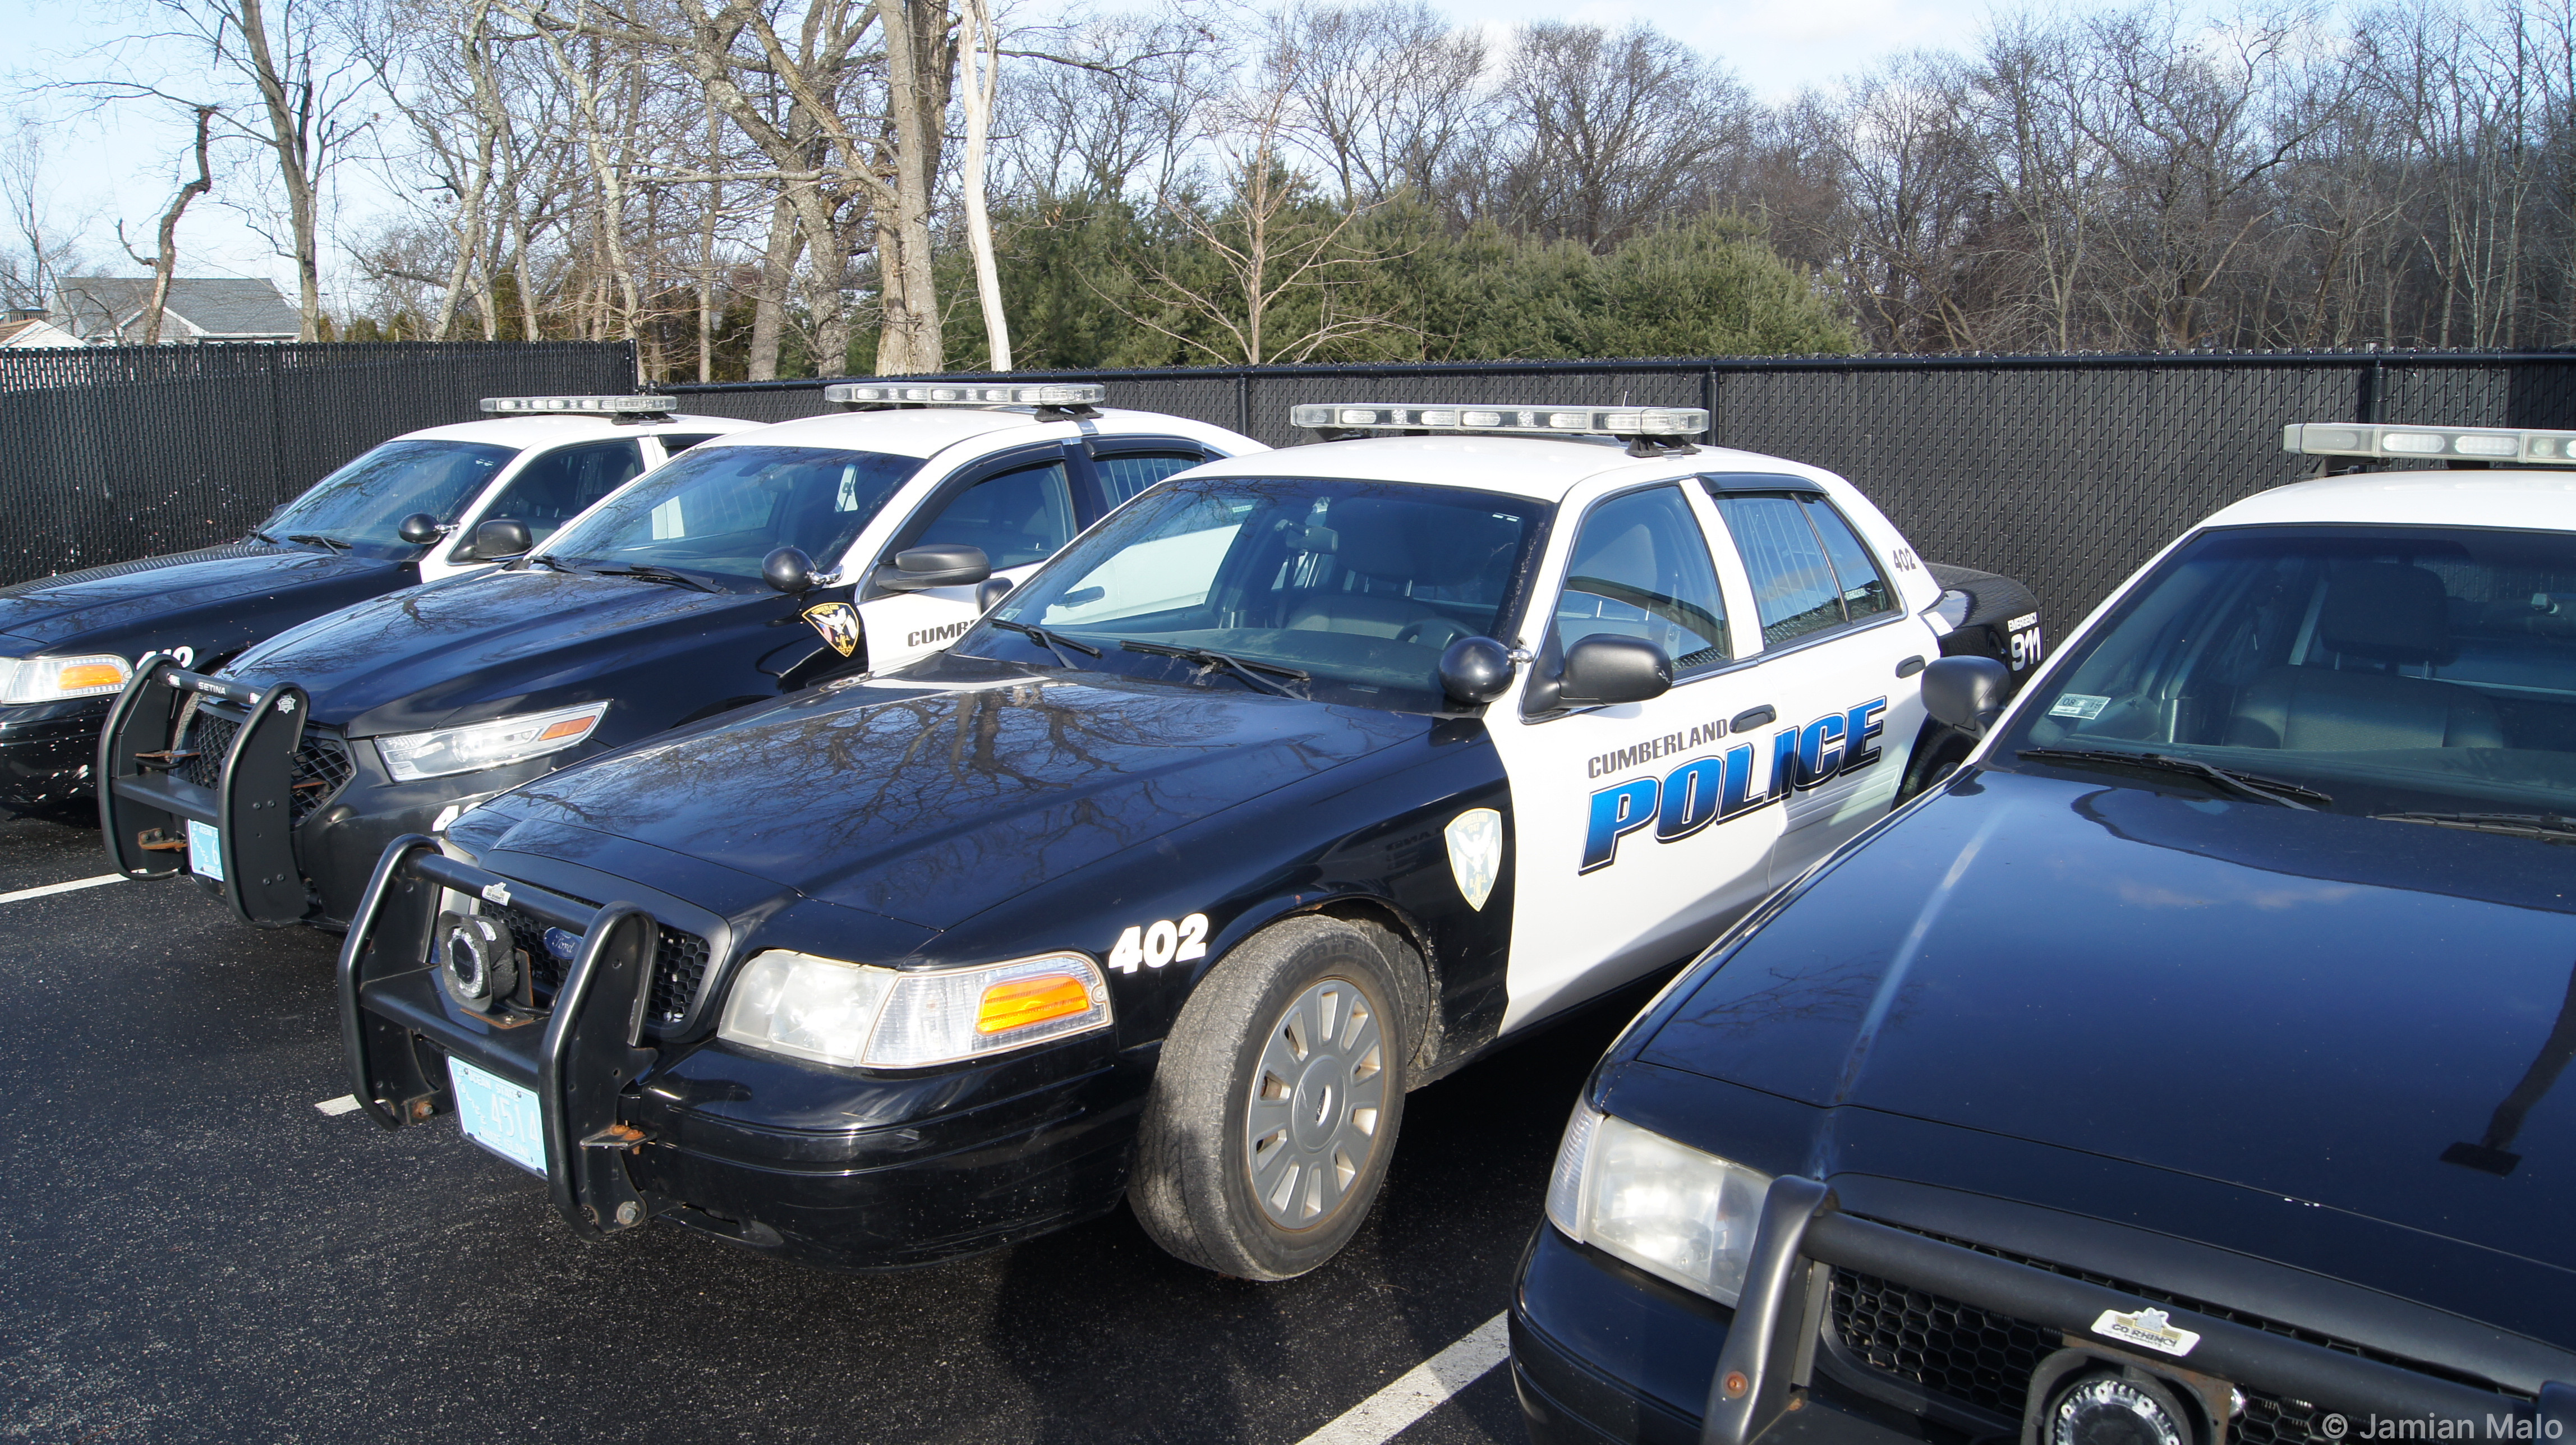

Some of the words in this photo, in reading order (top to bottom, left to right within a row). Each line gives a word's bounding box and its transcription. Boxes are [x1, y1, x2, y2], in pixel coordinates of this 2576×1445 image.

[1893, 547, 1916, 572] 402
[908, 618, 977, 647] CUMB
[2008, 611, 2037, 632] EMERGENCY
[2011, 627, 2041, 671] 911
[198, 682, 226, 695] SETINA
[1588, 719, 1728, 779] CUMBERLAND
[1578, 695, 1887, 876] POLICE
[552, 931, 576, 954] Ford
[1108, 913, 1209, 974] 402
[457, 1076, 487, 1125] POLICE
[496, 1084, 519, 1103] STATE
[491, 1093, 541, 1152] 4514
